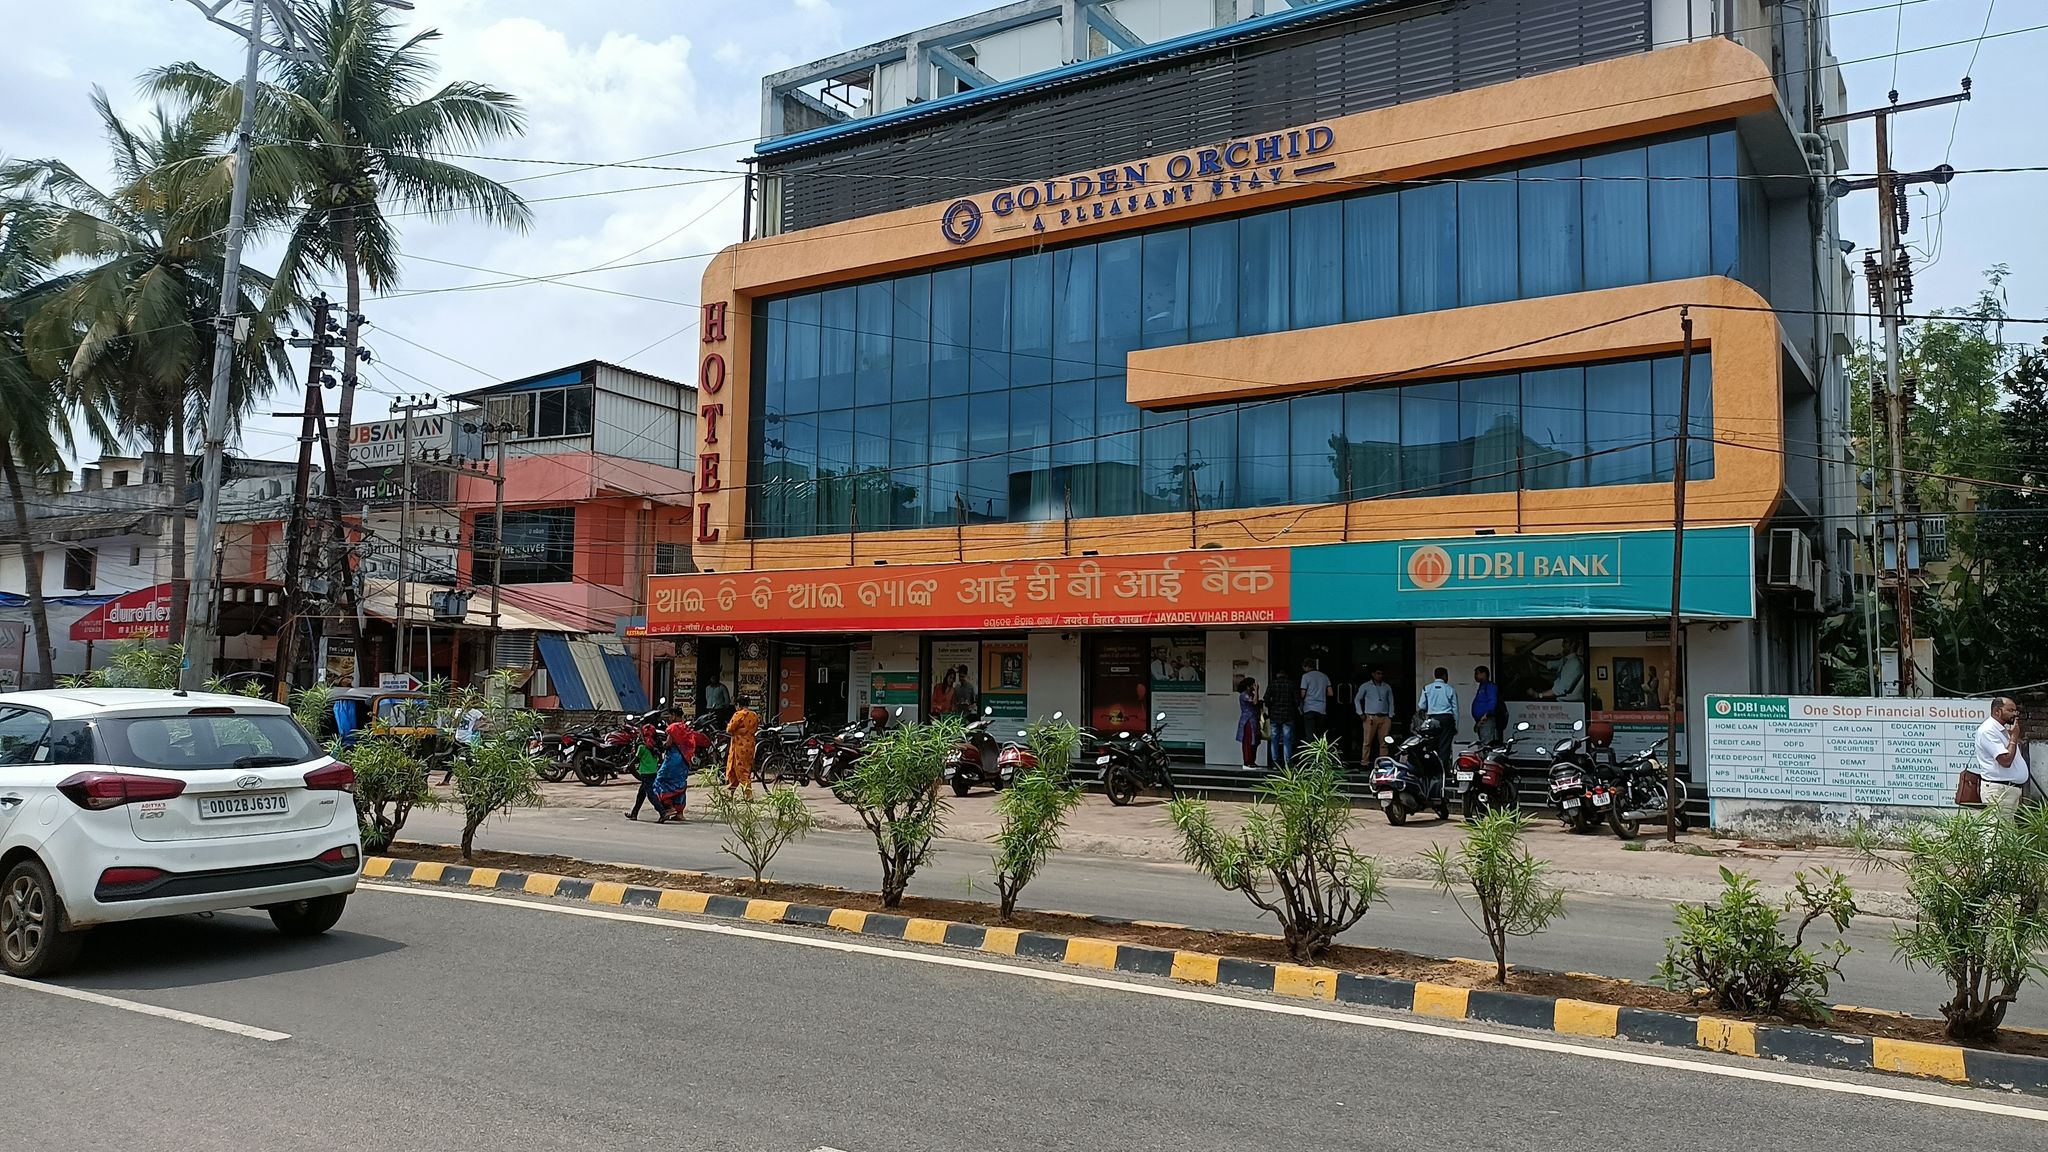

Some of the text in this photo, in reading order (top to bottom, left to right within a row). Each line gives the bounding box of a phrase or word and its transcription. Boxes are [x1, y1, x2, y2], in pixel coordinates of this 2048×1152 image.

[991, 126, 1335, 216] GOLDEN ORCHID
[1032, 167, 1283, 231] A PLEASANT STAY
[697, 301, 727, 543] HOTEL
[349, 439, 428, 460] COMPLX
[355, 485, 375, 499] THE
[1457, 551, 1610, 580] IDBI BANK
[956, 554, 1274, 608] आई डी बी आई बैंक
[655, 588, 706, 612] ଆଇ
[751, 577, 774, 610] ବି
[787, 582, 845, 609] ଆଇ
[109, 601, 171, 623] duroflex
[1062, 613, 1089, 626] जयदेव
[1092, 612, 1115, 625] विहार
[1119, 614, 1144, 624] शाखा
[1154, 610, 1274, 623] JAYADEV VIHAR BRANCH
[705, 623, 734, 632] e-Lobby
[1733, 702, 1786, 713] IDBI BANK
[1803, 705, 1985, 719] One Stop Financial Solution
